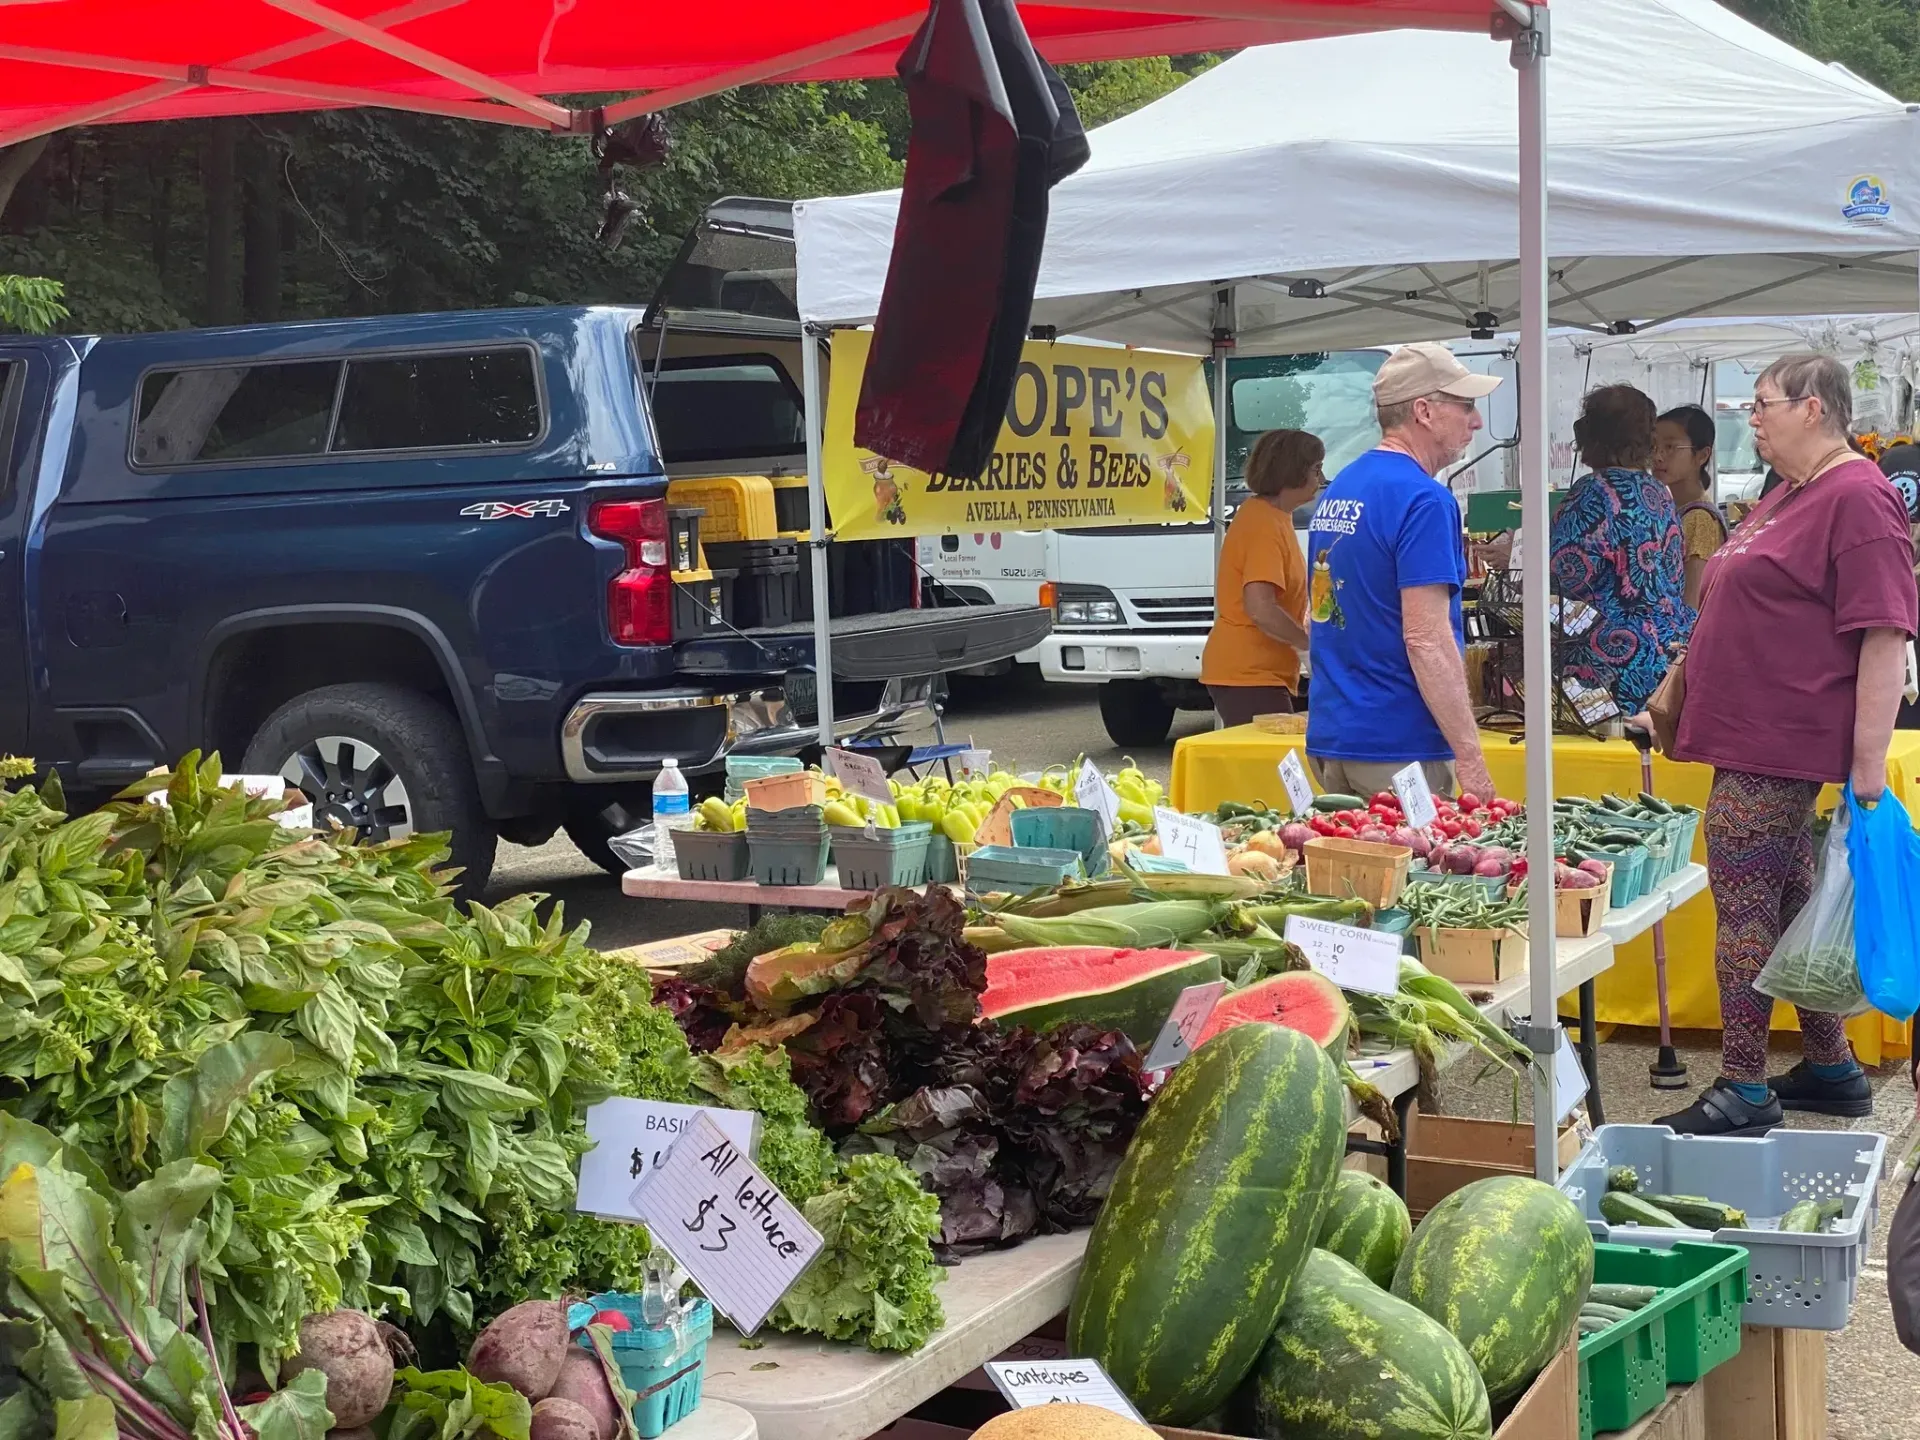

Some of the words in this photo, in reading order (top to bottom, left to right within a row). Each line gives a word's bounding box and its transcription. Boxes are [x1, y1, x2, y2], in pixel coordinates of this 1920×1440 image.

[1056, 443, 1079, 489] &
[965, 500, 1022, 525] AVELLA,
[1027, 497, 1117, 521] PENNSYLVANIA
[1000, 568, 1026, 577] ISUZU
[1157, 810, 1182, 825] GREEN
[1181, 816, 1204, 832] BEANS
[1299, 920, 1338, 936] SWEET
[1339, 928, 1372, 942] CORN
[700, 1140, 739, 1178] All
[734, 1175, 800, 1259] lettuce
[682, 1194, 737, 1252] $3
